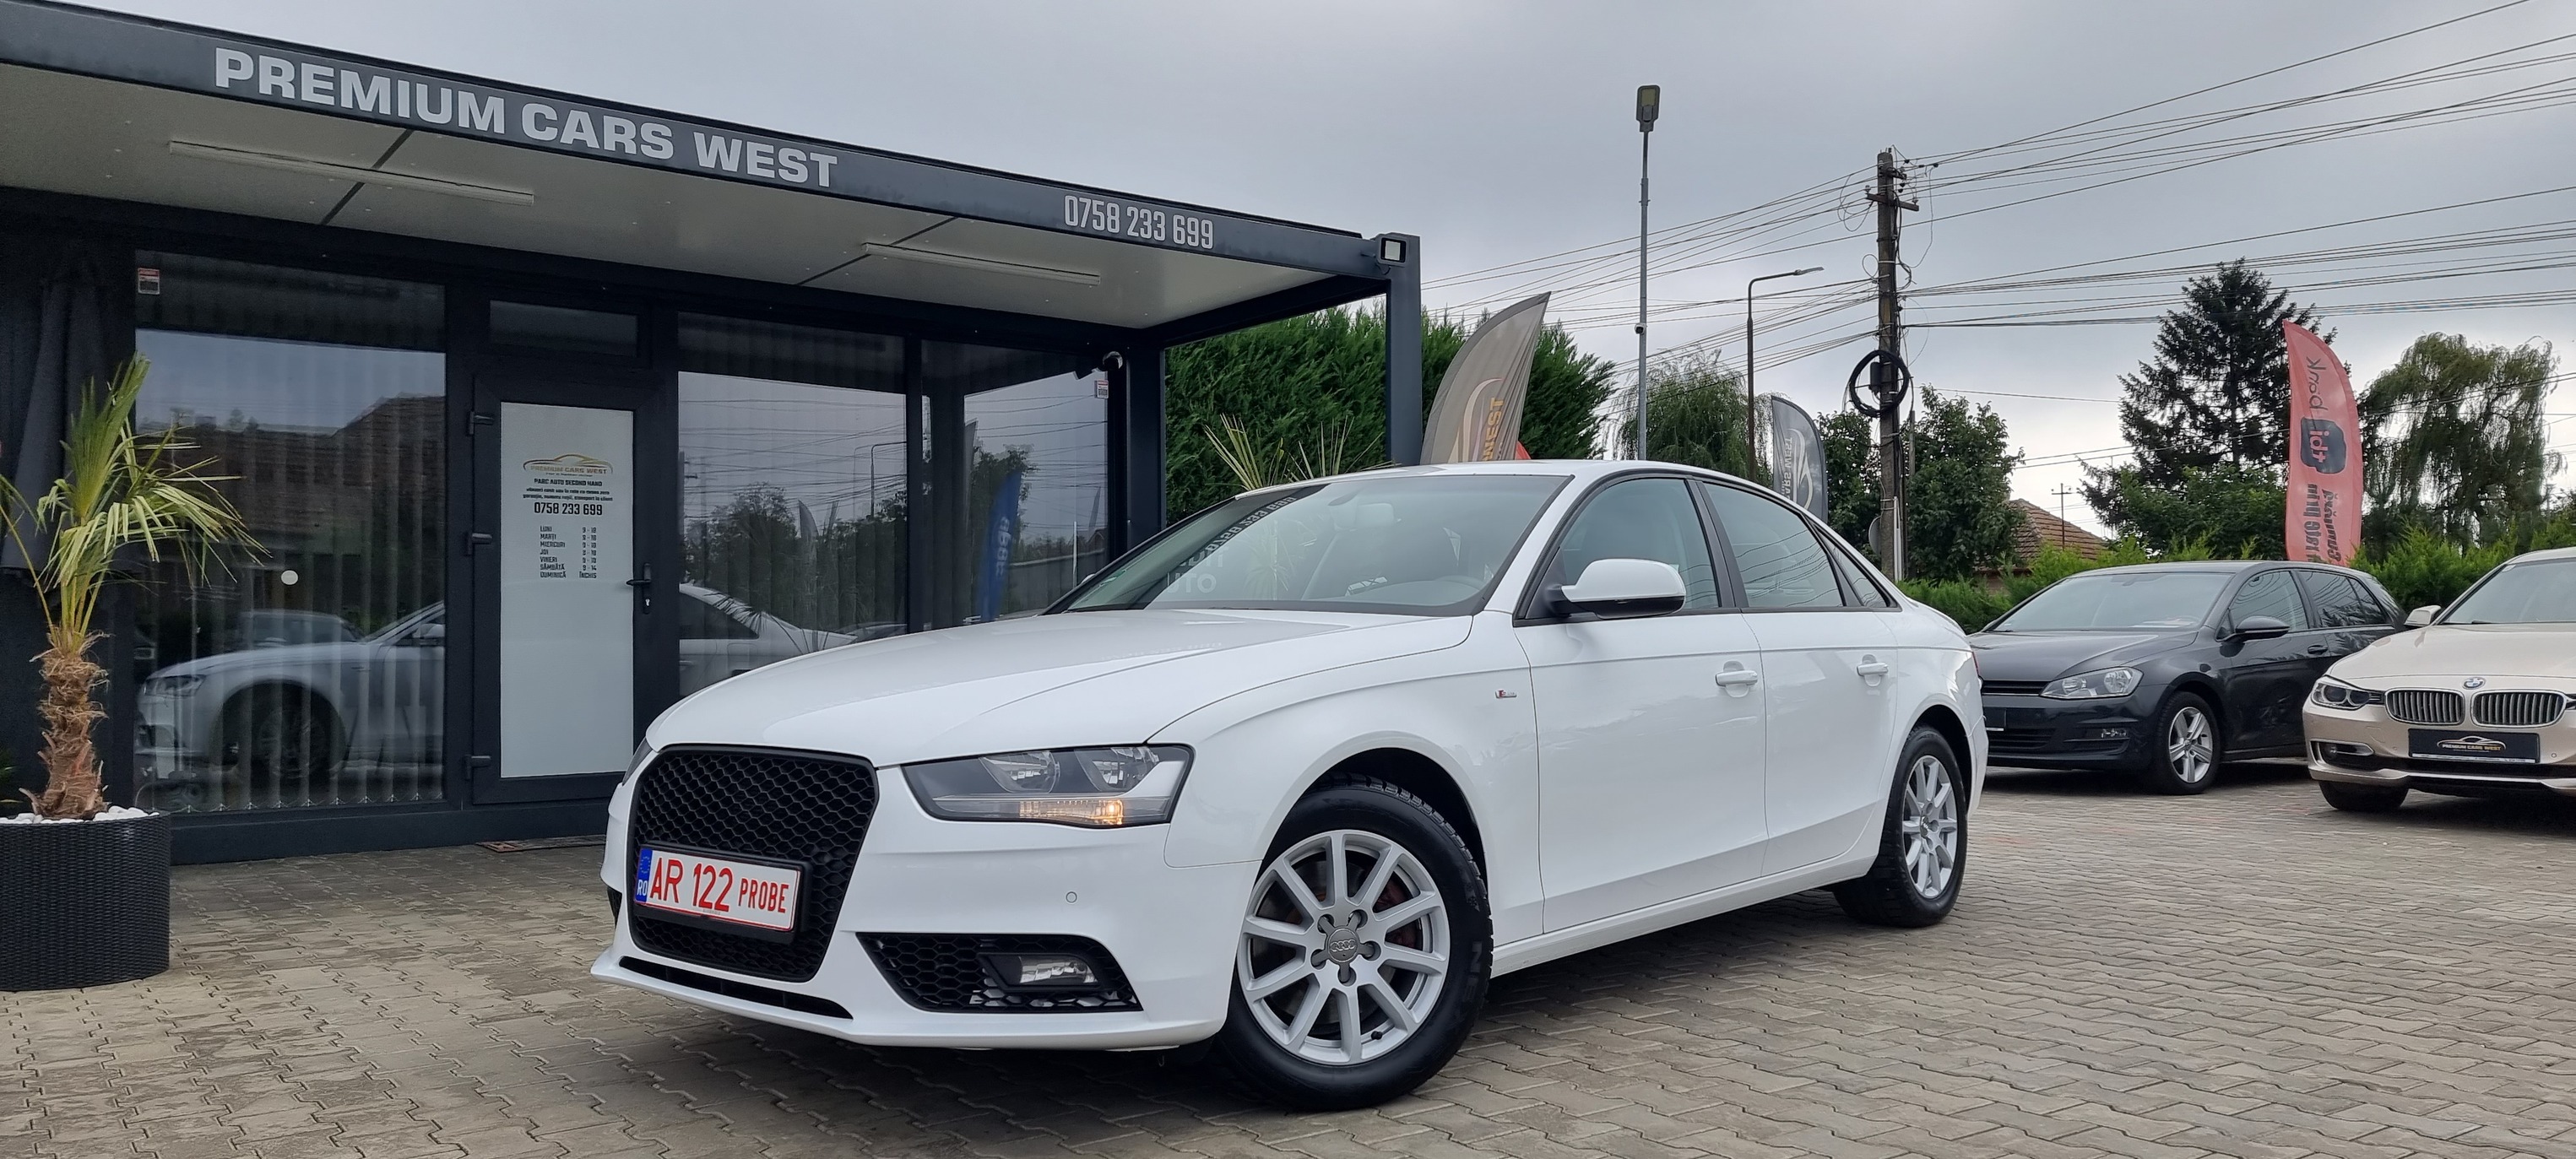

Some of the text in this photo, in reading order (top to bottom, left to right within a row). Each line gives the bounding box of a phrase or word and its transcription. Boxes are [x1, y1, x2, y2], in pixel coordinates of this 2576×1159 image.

[215, 47, 838, 187] PREMIUM CARS WEST
[1064, 195, 1213, 249] 0758 233 699
[534, 501, 603, 516] 0758 233 699
[637, 880, 648, 896] RO
[649, 857, 789, 914] AR 122 PROBE
